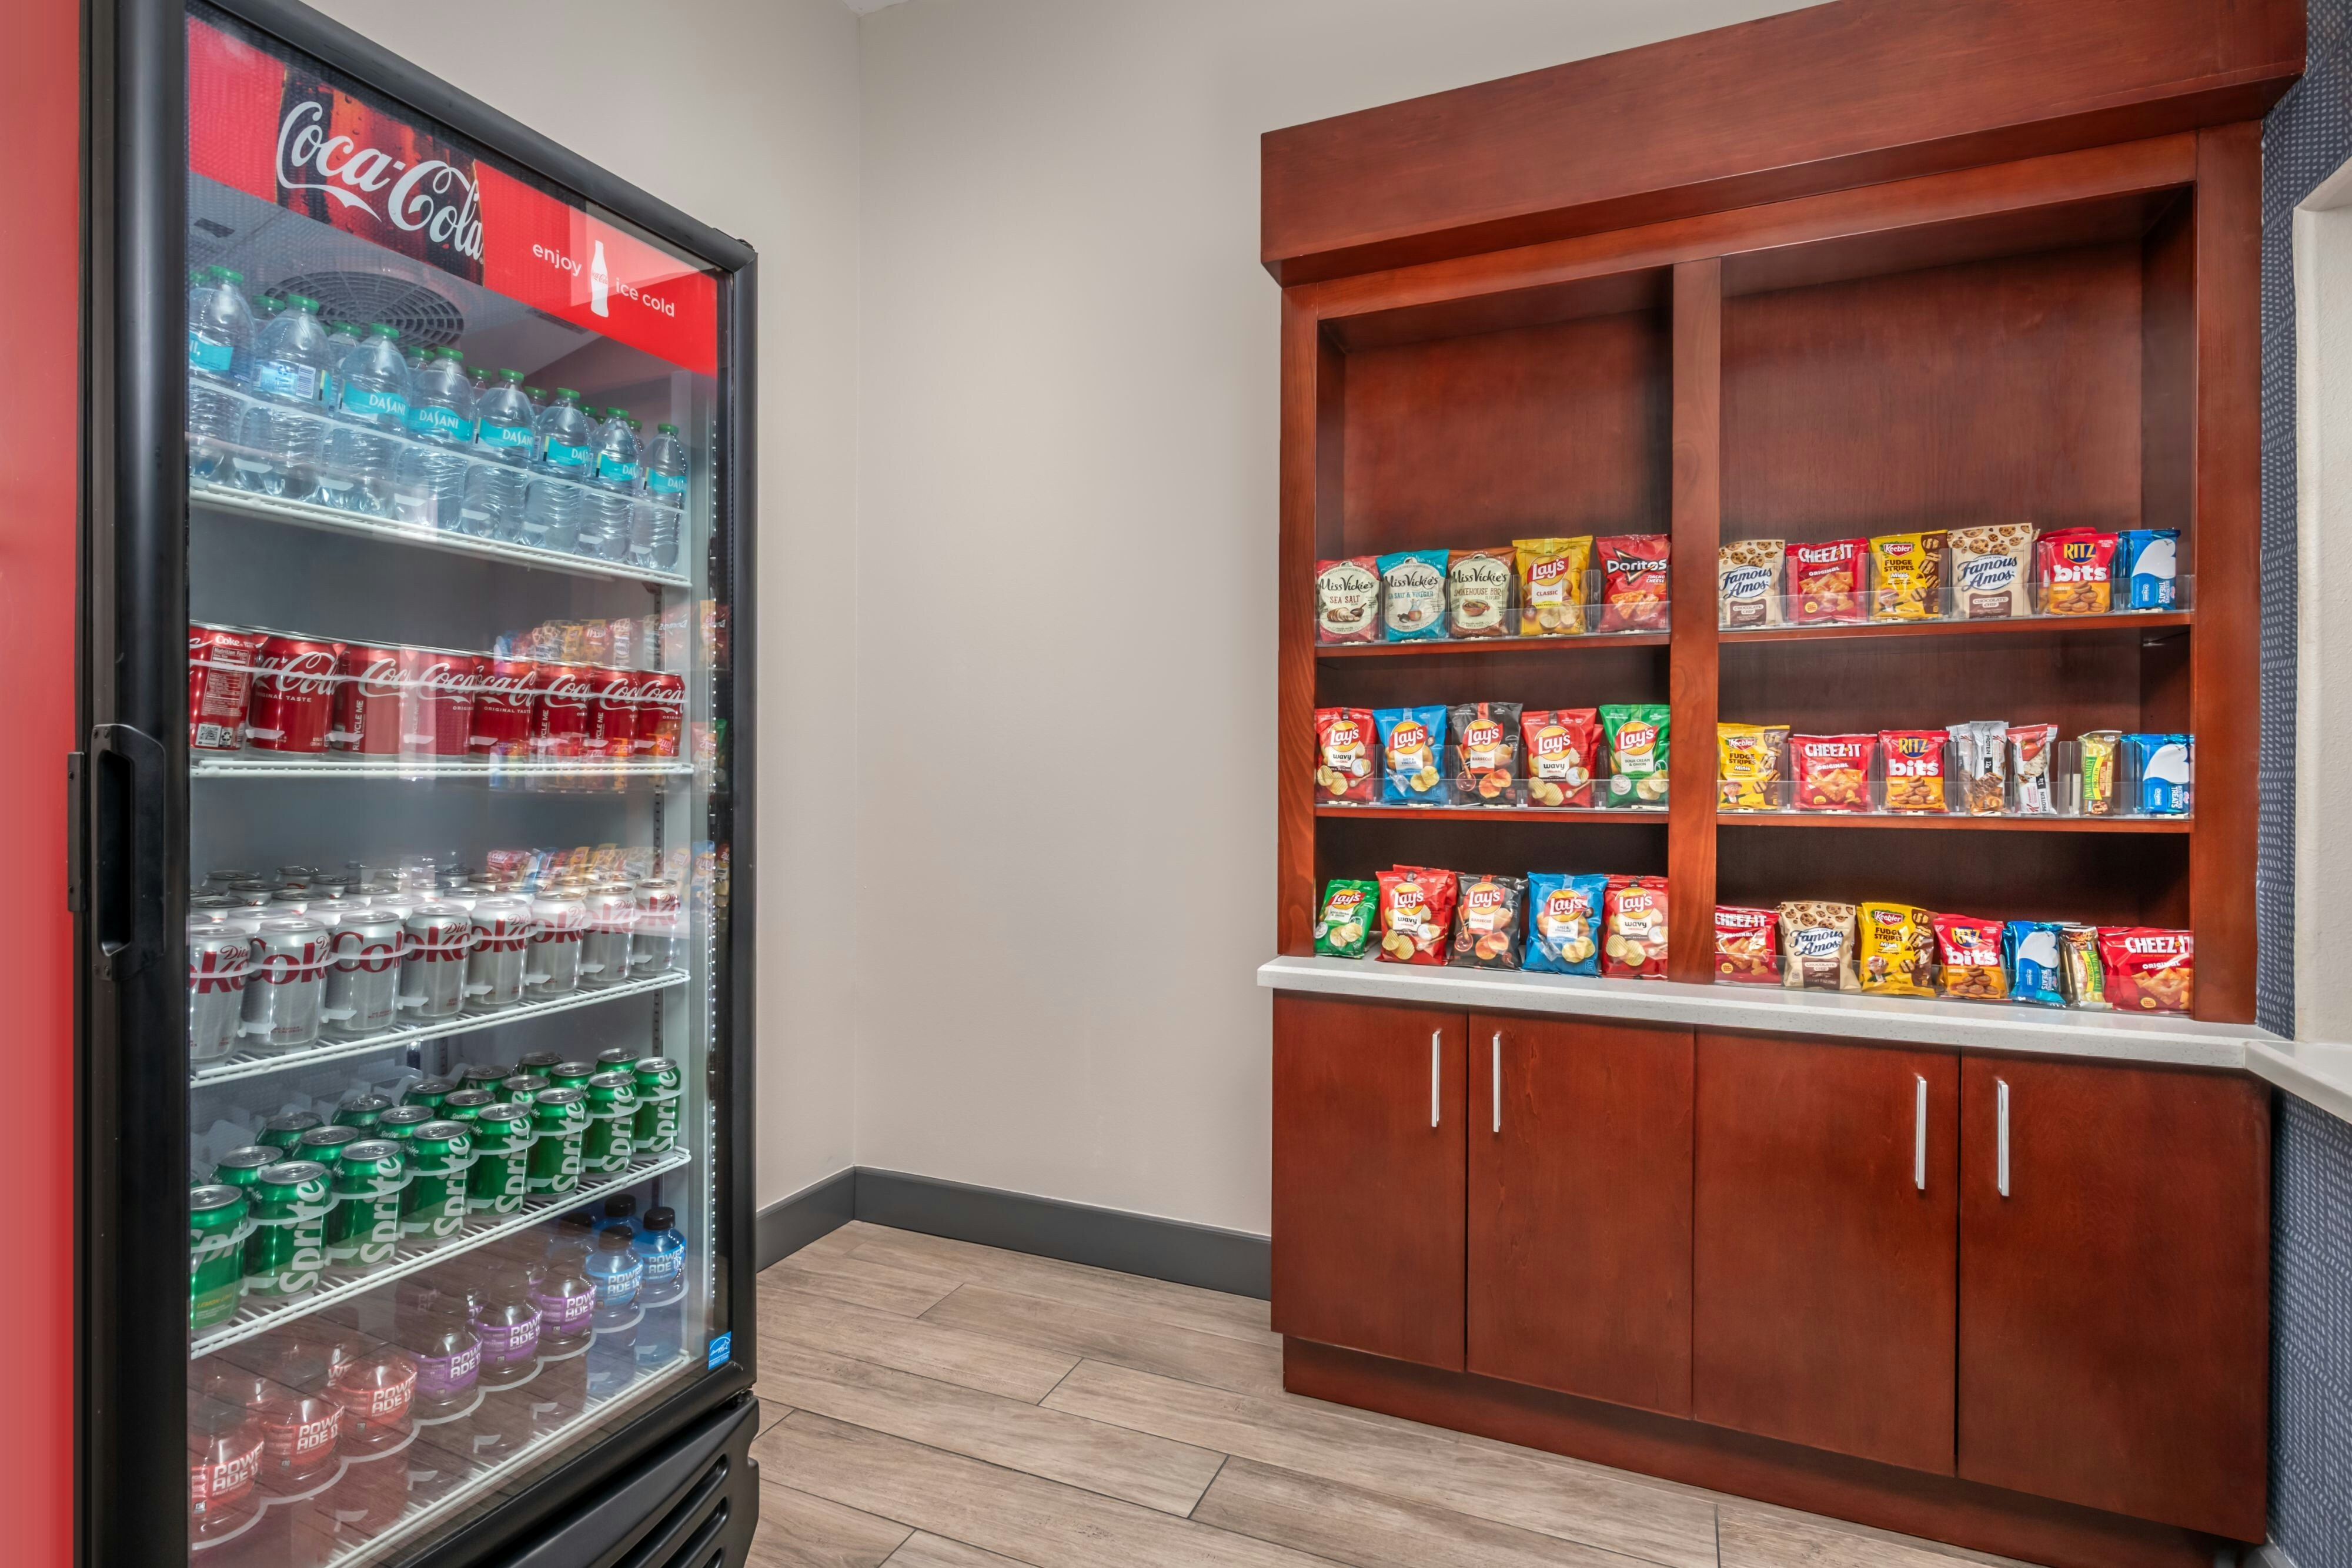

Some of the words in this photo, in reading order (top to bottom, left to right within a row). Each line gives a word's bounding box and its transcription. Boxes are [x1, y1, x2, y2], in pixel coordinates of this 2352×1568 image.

[276, 101, 484, 262] Coca-Cola
[533, 243, 582, 277] enjoy
[616, 277, 639, 300] ice
[643, 294, 675, 317] cold
[369, 394, 406, 415] DASANI
[419, 409, 459, 430] DASANI
[1885, 544, 1911, 554] Keebler
[2063, 543, 2096, 560] RITZ
[1532, 559, 1565, 580] Lay's
[1606, 559, 1667, 572] Doritos
[1808, 566, 1840, 577] ORIGINAL
[1957, 556, 2017, 582] Famous
[2053, 564, 2107, 582] bits
[1341, 574, 1374, 593] Vickie's
[1404, 571, 1439, 589] Vickie's
[1472, 565, 1507, 586] Vickie's
[1719, 567, 1772, 591] Famous
[1962, 570, 2015, 592] Amos
[1345, 595, 1360, 603] SALT
[1454, 588, 1488, 597] SMOKEHOUSE
[1490, 588, 1502, 596] BBQ
[1723, 580, 1769, 600] Amos
[215, 635, 240, 647] Coke
[356, 700, 364, 713] ME
[542, 710, 549, 721] ME
[597, 712, 604, 723] ME
[1330, 727, 1359, 746] Lay's
[1394, 727, 1424, 749] Lay's
[1468, 726, 1499, 747] Lay's
[1538, 733, 1571, 755] Lay's
[1621, 728, 1655, 750] Lay's
[1730, 739, 1755, 748] Keebler
[1898, 737, 1929, 753] RITZ
[1888, 758, 1939, 776] bits
[1331, 892, 1361, 906] Lay's
[1394, 891, 1424, 908] Lay's
[1468, 890, 1500, 908] Lay's
[1549, 896, 1583, 915] Lay's
[1619, 894, 1652, 913] Lay's
[1398, 917, 1417, 925] wavy
[1876, 912, 1902, 922] Keebler
[442, 921, 468, 934] Diet
[1875, 927, 1902, 935] FUDGE
[1951, 927, 1981, 945] RITZ
[405, 925, 470, 963] oke
[1789, 930, 1844, 948] Famous
[1794, 941, 1841, 956] Amos
[1945, 944, 1998, 965] bits
[650, 1070, 677, 1152] Sprite
[602, 1086, 634, 1172] Sprite
[552, 1101, 586, 1192] Sprite
[495, 1118, 529, 1213] Sprite
[433, 1132, 470, 1236] Sprite
[360, 1156, 401, 1263] Sprite
[279, 1178, 325, 1293] Sprite
[649, 1262, 671, 1273] ADE
[607, 1282, 631, 1295] ADE
[565, 1305, 589, 1319] ADE
[510, 1331, 534, 1348] ADE
[450, 1360, 476, 1379] ADE
[372, 1396, 402, 1413] ADE
[297, 1429, 328, 1450] ADE
[212, 1470, 248, 1492] ADE
